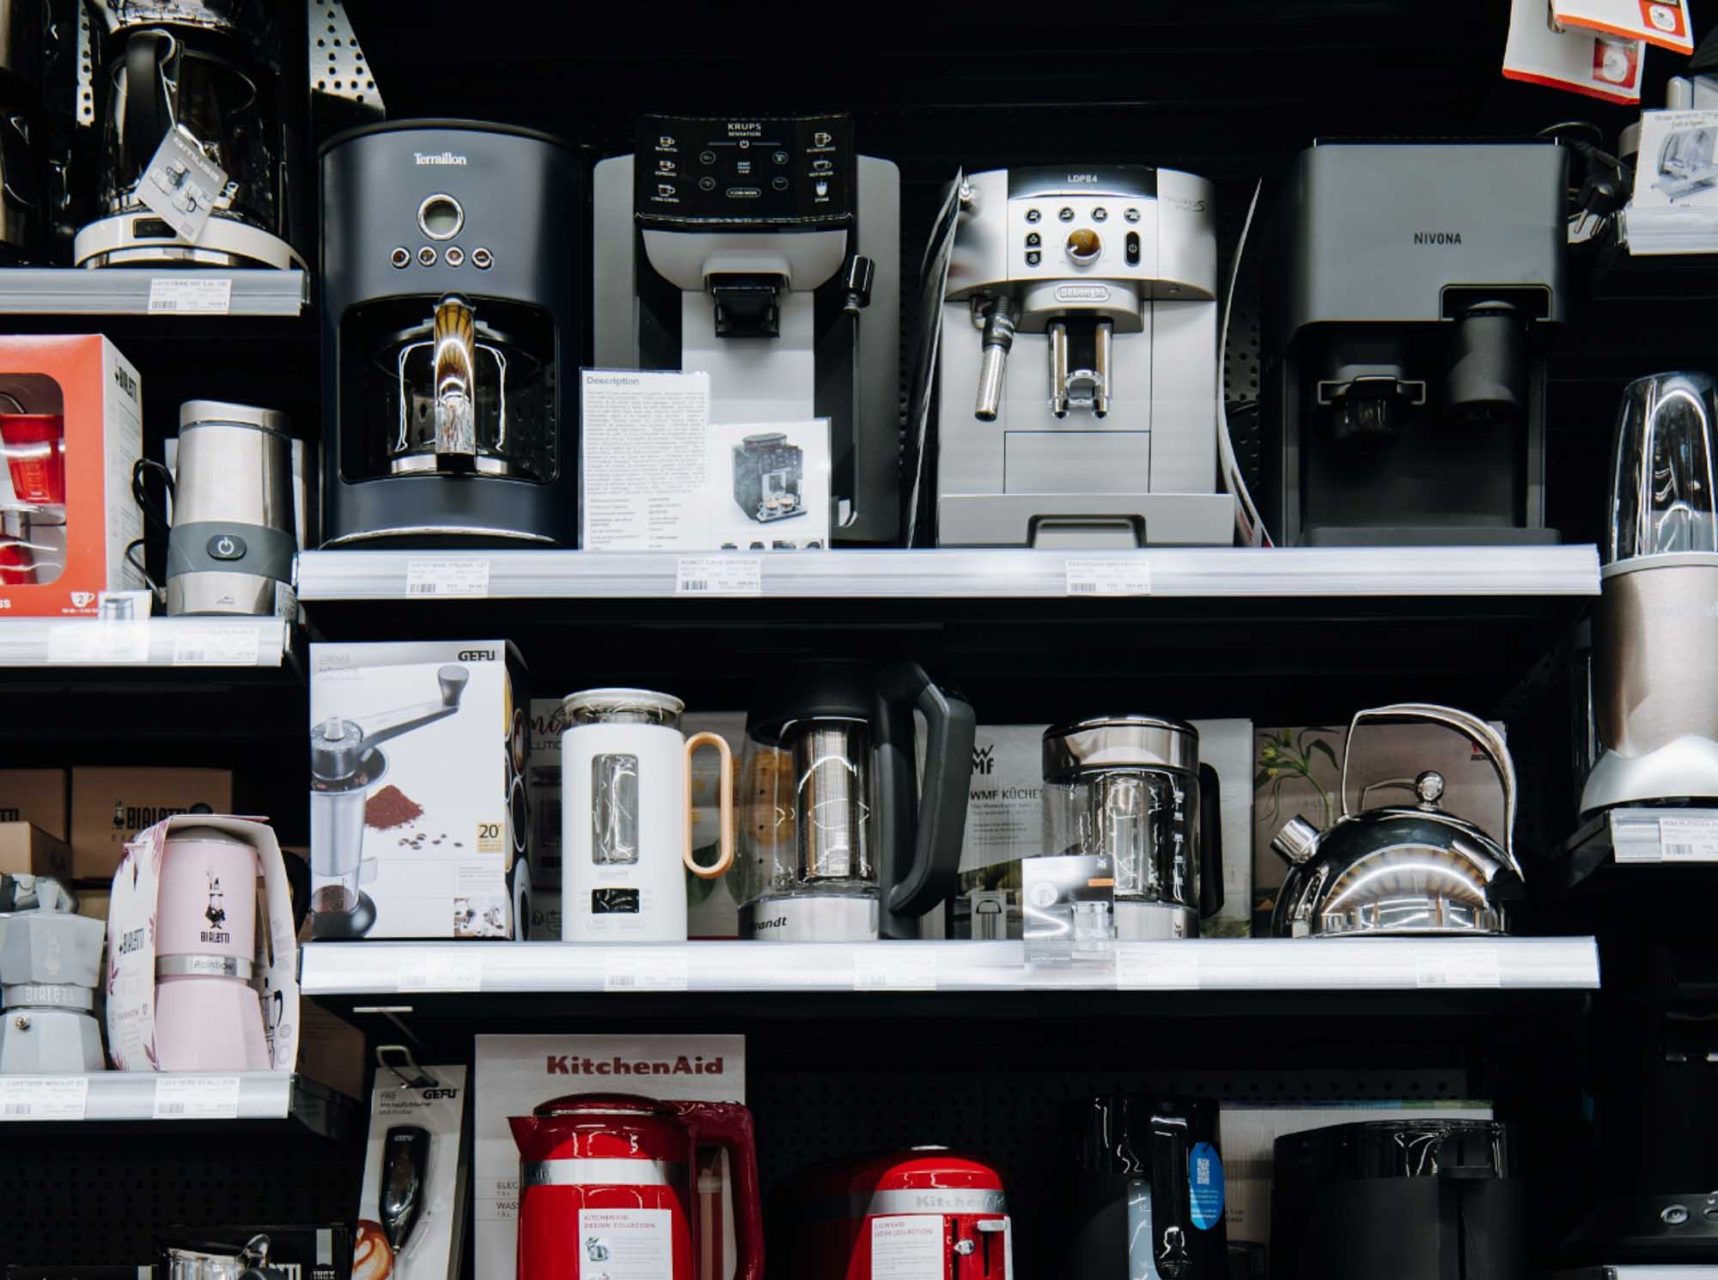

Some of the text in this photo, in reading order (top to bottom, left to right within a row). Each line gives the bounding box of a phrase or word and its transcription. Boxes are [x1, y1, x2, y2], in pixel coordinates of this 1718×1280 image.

[727, 123, 762, 131] KRUPS
[413, 152, 467, 165] Terraillon
[1413, 231, 1462, 245] NIVONA
[586, 376, 640, 386] Description
[457, 650, 496, 661] GEFU
[970, 790, 999, 801] WMF
[200, 931, 230, 943] BIALETTI
[546, 1055, 724, 1076] KitchenAid
[422, 1088, 458, 1099] GEFU
[313, 1270, 335, 1280] INOX
